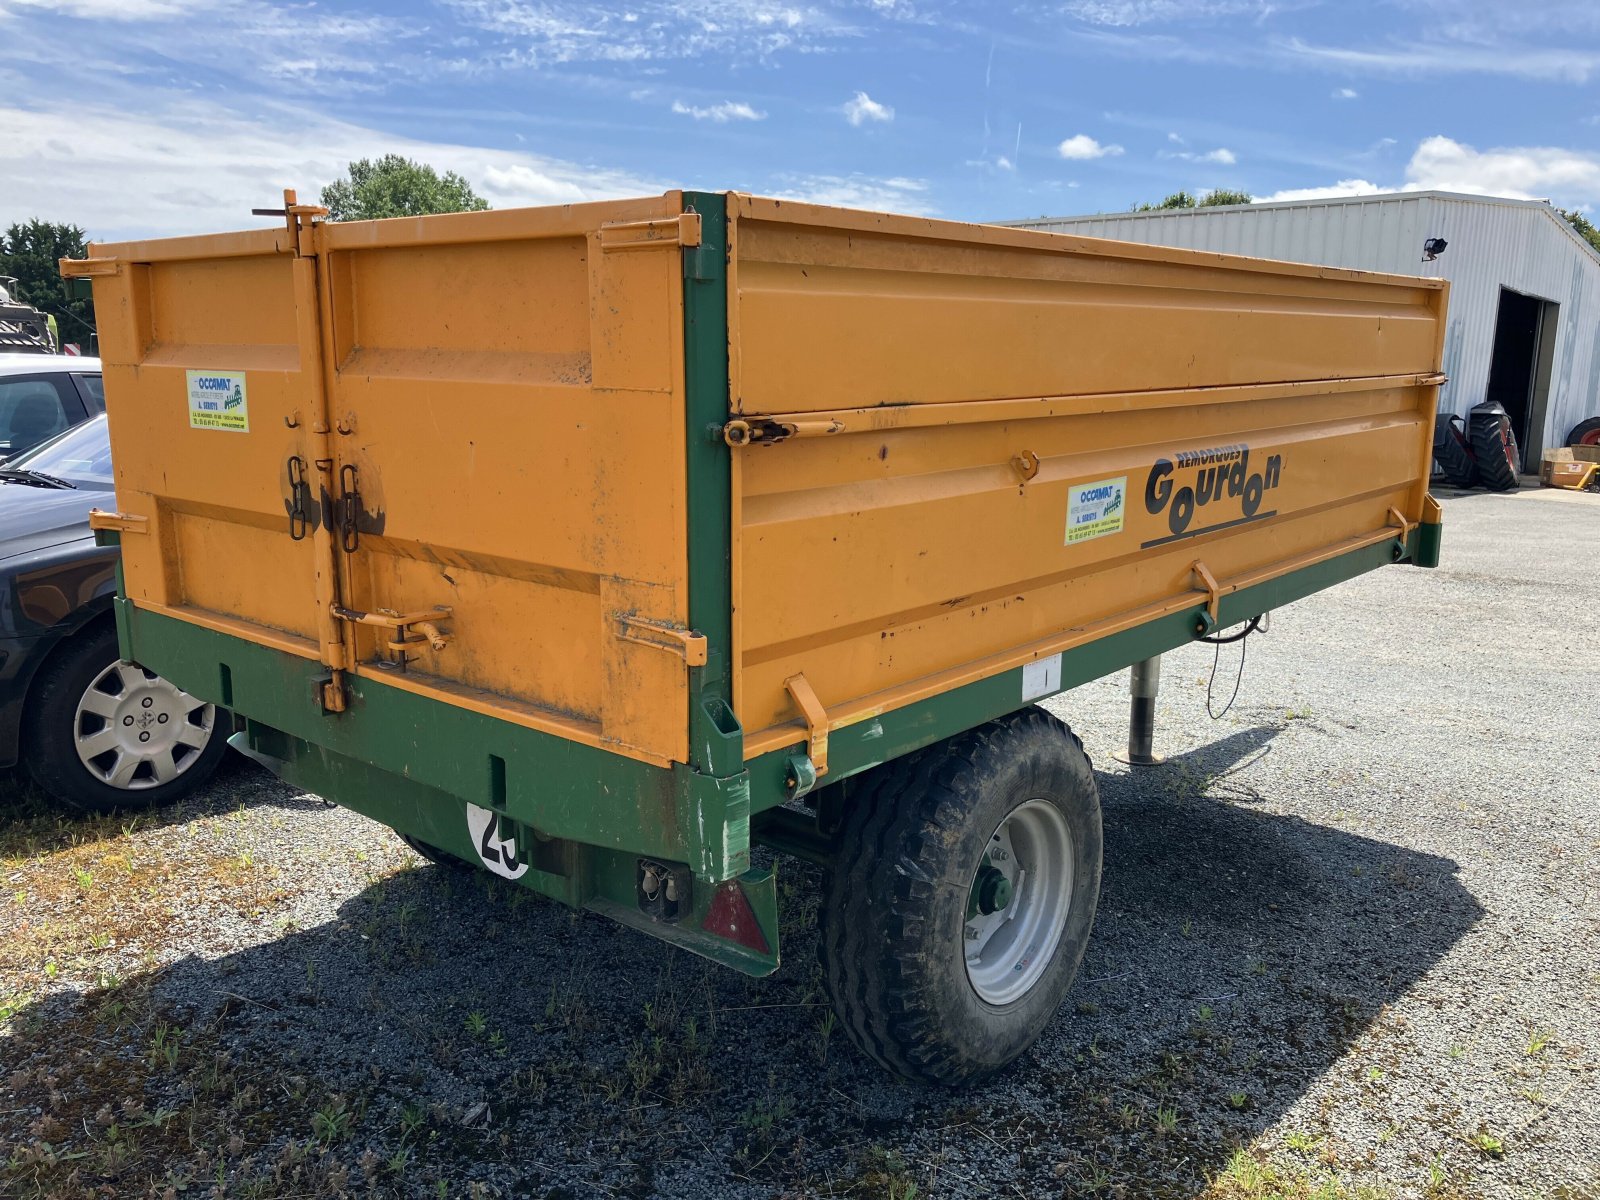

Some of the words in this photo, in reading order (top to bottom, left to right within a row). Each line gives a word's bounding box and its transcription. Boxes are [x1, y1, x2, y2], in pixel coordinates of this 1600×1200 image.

[198, 377, 231, 391] OCCAMAT
[1174, 445, 1241, 469] REMORQUES
[1080, 485, 1114, 504] OCCAMAT
[1145, 443, 1281, 534] Gourdon
